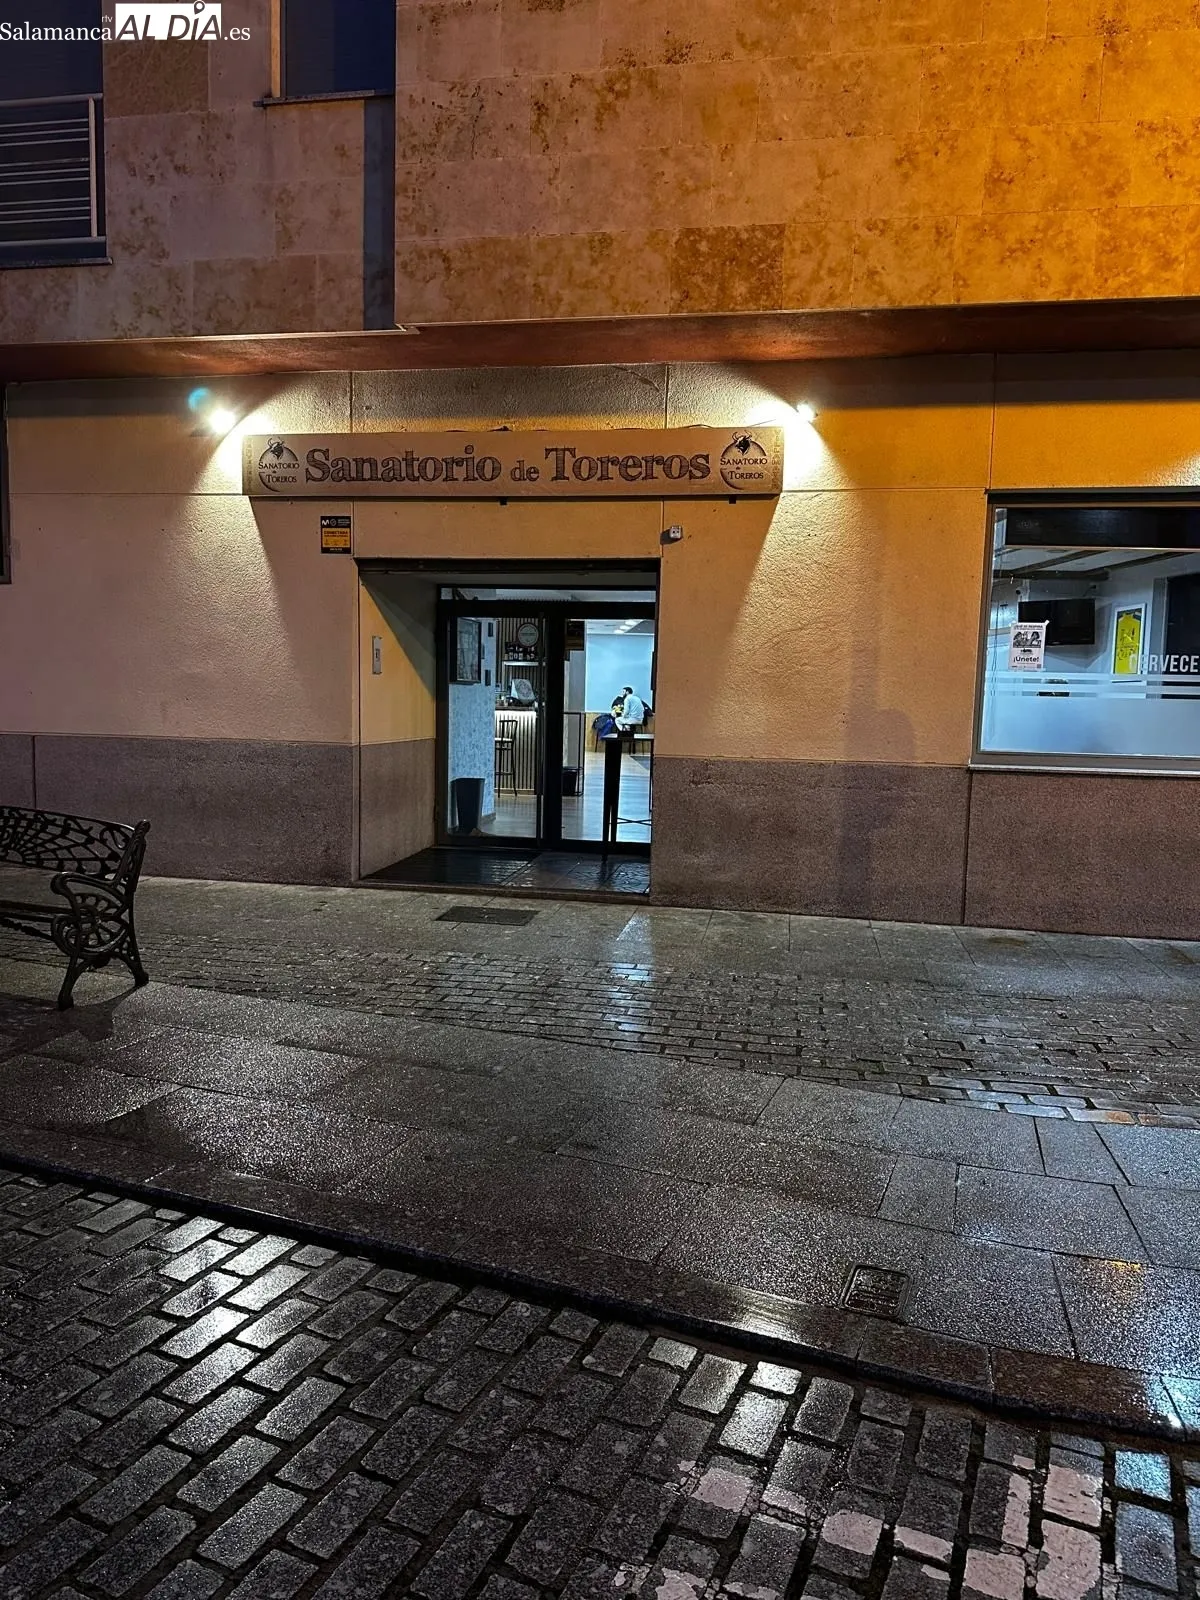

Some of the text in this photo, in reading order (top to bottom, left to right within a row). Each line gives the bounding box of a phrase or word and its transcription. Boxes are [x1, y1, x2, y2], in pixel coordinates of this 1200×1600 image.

[305, 445, 711, 483] Sanatorio de Toreros
